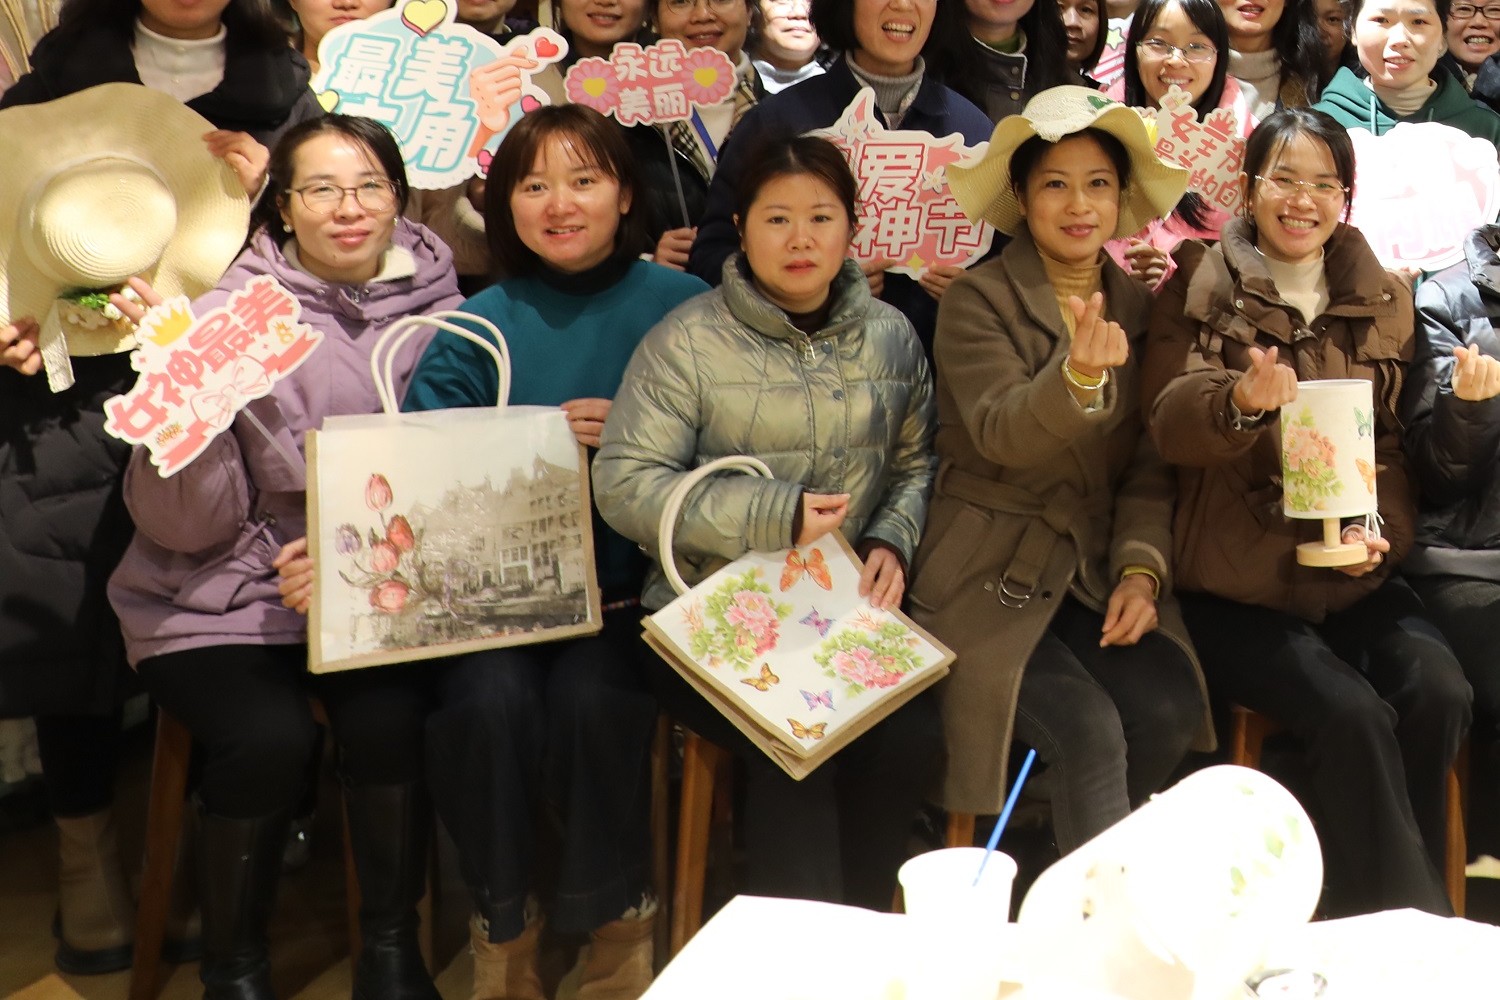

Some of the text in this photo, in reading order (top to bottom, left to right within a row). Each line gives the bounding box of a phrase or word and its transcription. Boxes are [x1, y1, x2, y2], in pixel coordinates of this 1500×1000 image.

[330, 32, 474, 101] 最美
[614, 45, 683, 82] 永远
[618, 83, 685, 120] 美丽
[842, 143, 926, 205] 爱
[110, 280, 294, 439] 女神最美
